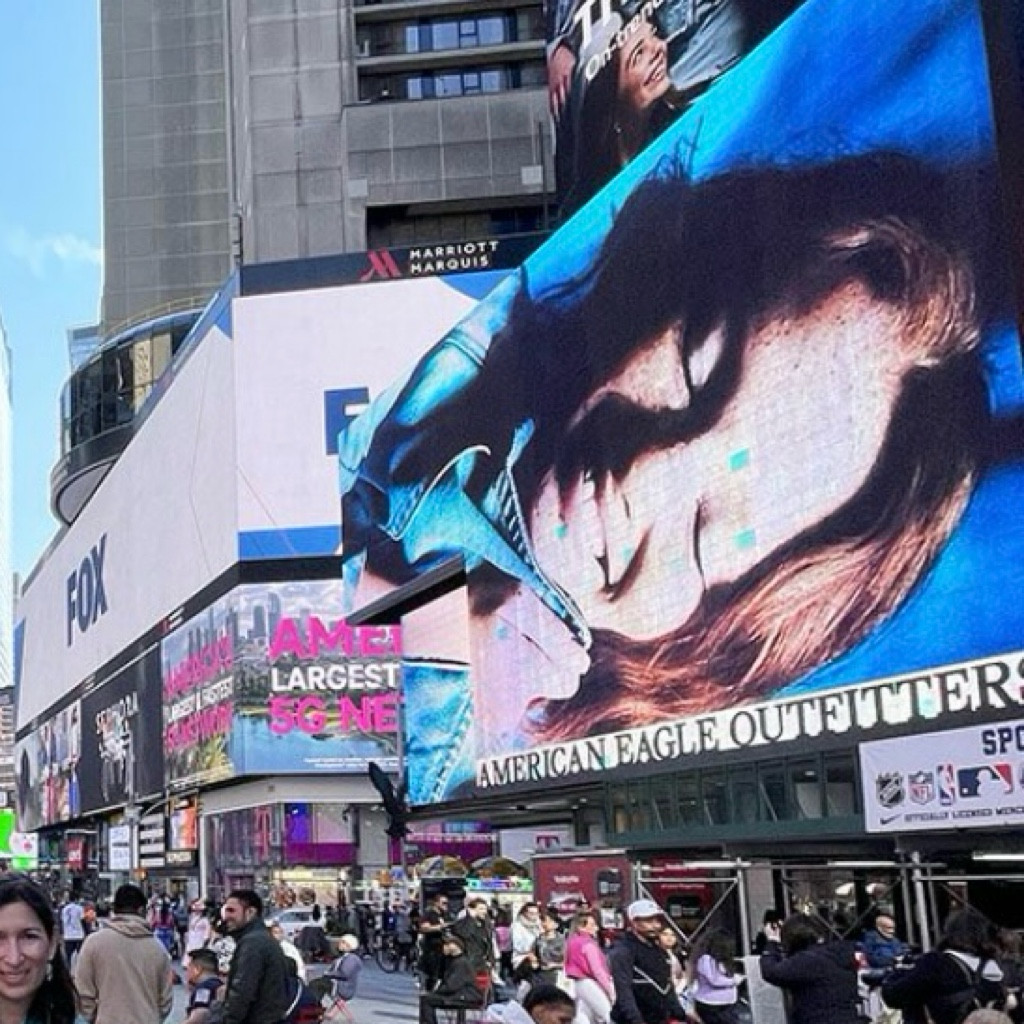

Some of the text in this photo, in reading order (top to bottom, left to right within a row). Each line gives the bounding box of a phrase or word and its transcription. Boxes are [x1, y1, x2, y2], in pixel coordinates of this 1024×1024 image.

[409, 240, 499, 261] MARRIOTT
[410, 255, 489, 275] MARQUIS
[66, 531, 108, 647] FOX
[271, 663, 400, 691] LARGEST
[268, 693, 327, 734] 5G
[476, 659, 1024, 787] AMERICAN EAGLE OUTFITTER
